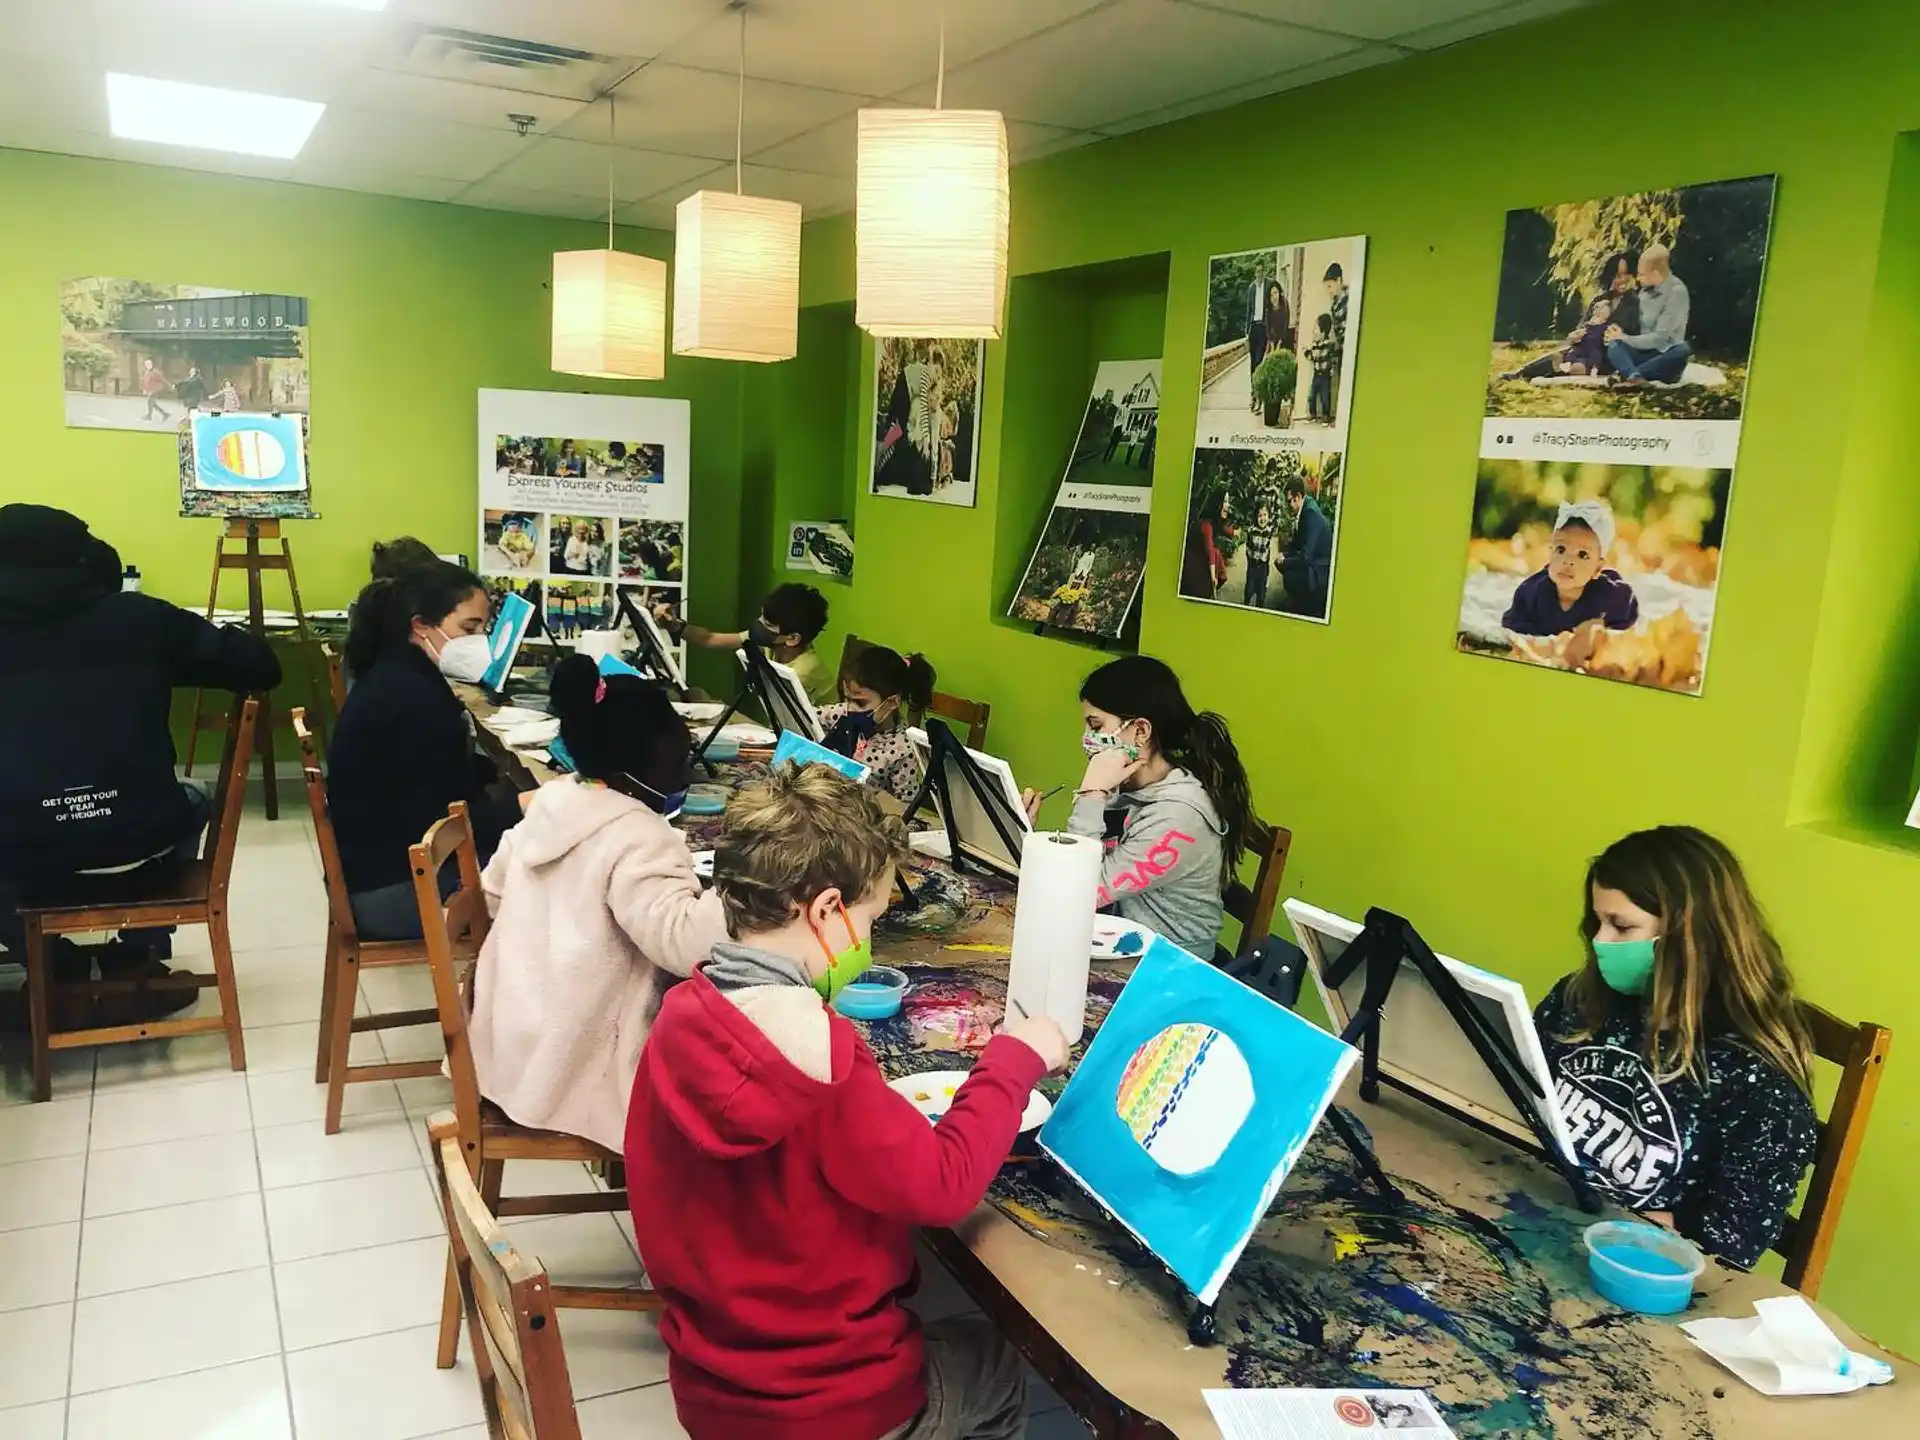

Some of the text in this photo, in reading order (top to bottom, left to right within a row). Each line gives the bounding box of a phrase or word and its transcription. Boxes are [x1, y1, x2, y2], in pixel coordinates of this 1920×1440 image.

[156, 316, 284, 329] MAPLEWOOD
[507, 475, 648, 494] Express Yourself Studios
[42, 789, 118, 808] GET OVER YOUR
[69, 801, 95, 812] FEAR
[55, 807, 112, 822] OF HEIGHTS
